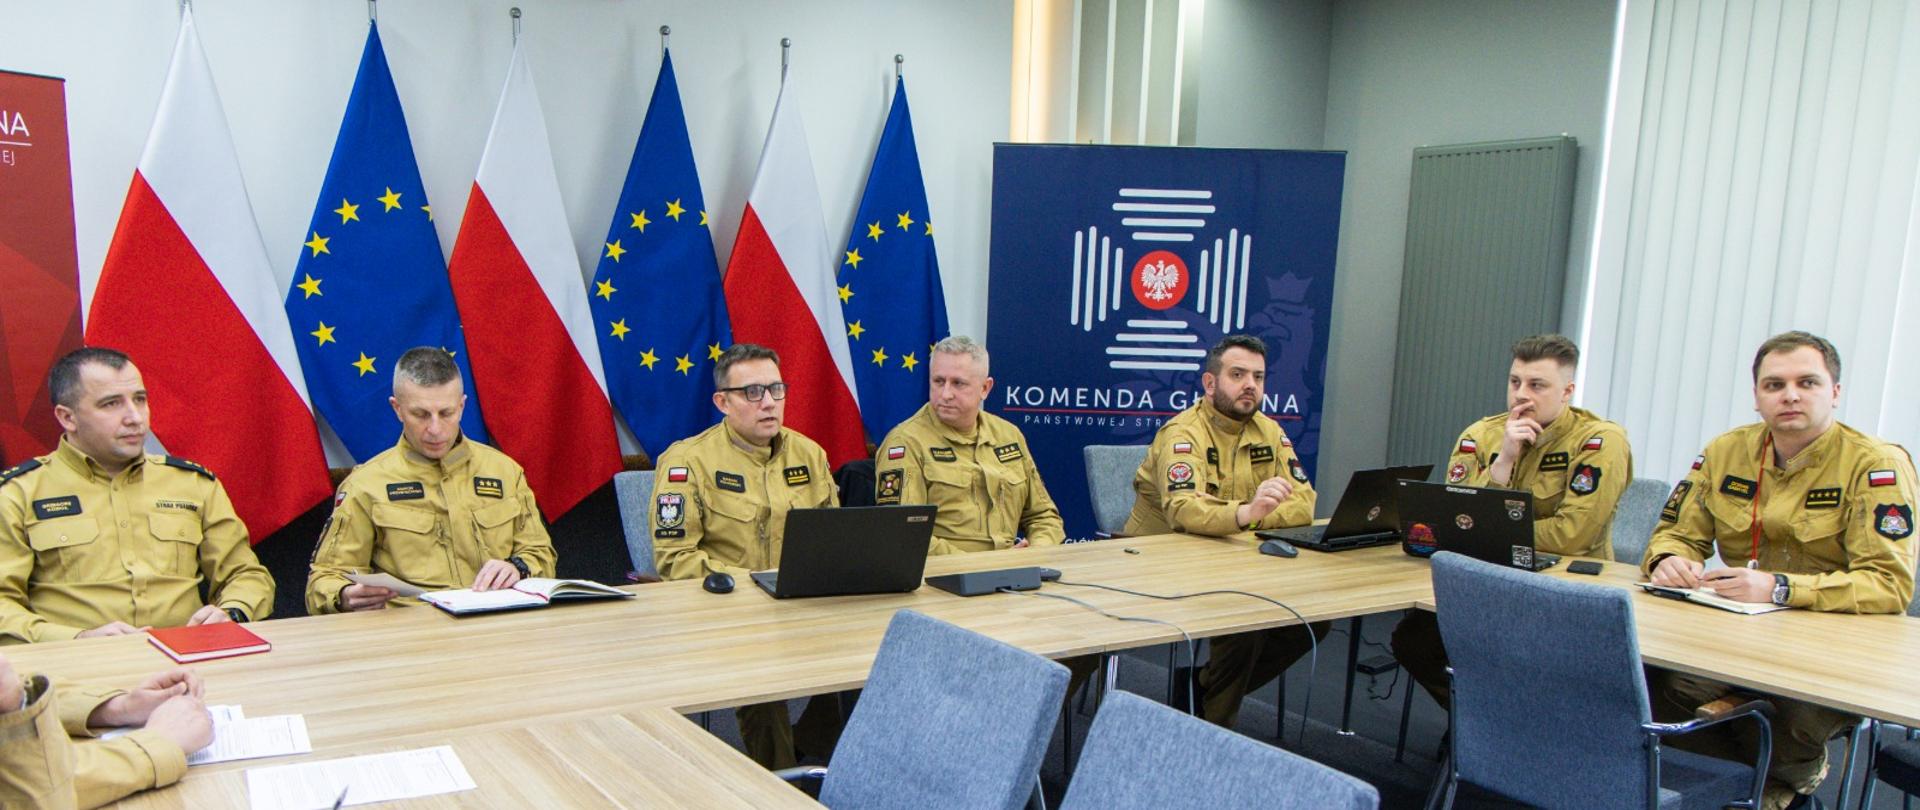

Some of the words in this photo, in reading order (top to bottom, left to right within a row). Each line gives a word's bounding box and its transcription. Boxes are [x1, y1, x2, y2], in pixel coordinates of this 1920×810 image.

[1006, 386, 1154, 409] KOMENDA
[1169, 390, 1299, 414] GŁNA
[1024, 414, 1125, 427] PAŃSTWOWEJ
[1135, 418, 1162, 428] STR
